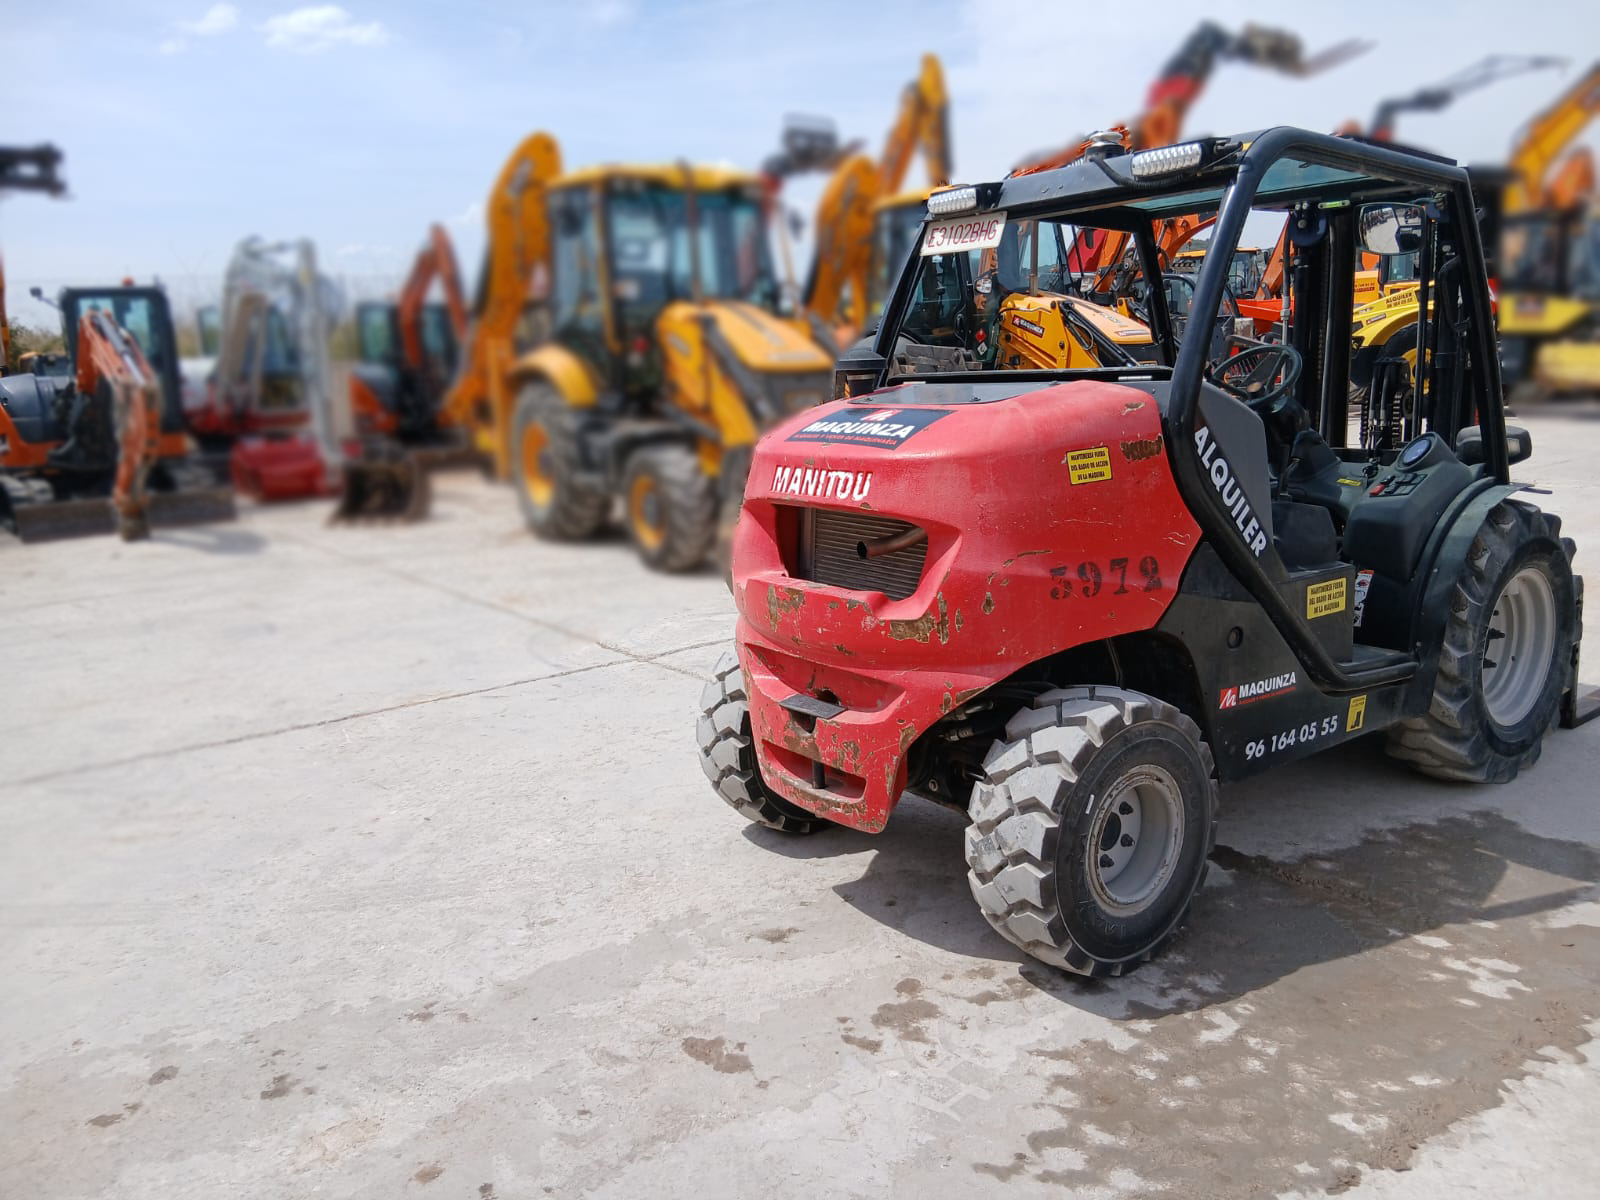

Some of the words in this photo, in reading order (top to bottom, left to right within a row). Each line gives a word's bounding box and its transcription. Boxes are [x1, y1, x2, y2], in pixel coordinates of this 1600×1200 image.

[927, 219, 999, 248] E3102BHG
[802, 421, 915, 438] MAQUINZA
[770, 466, 874, 501] MANITOU
[1194, 426, 1267, 558] ALQUILER
[1239, 671, 1297, 699] MAQUINZA
[1245, 739, 1265, 760] 96
[1271, 729, 1296, 752] 164
[1300, 721, 1317, 742] 05
[1321, 715, 1338, 735] 55
